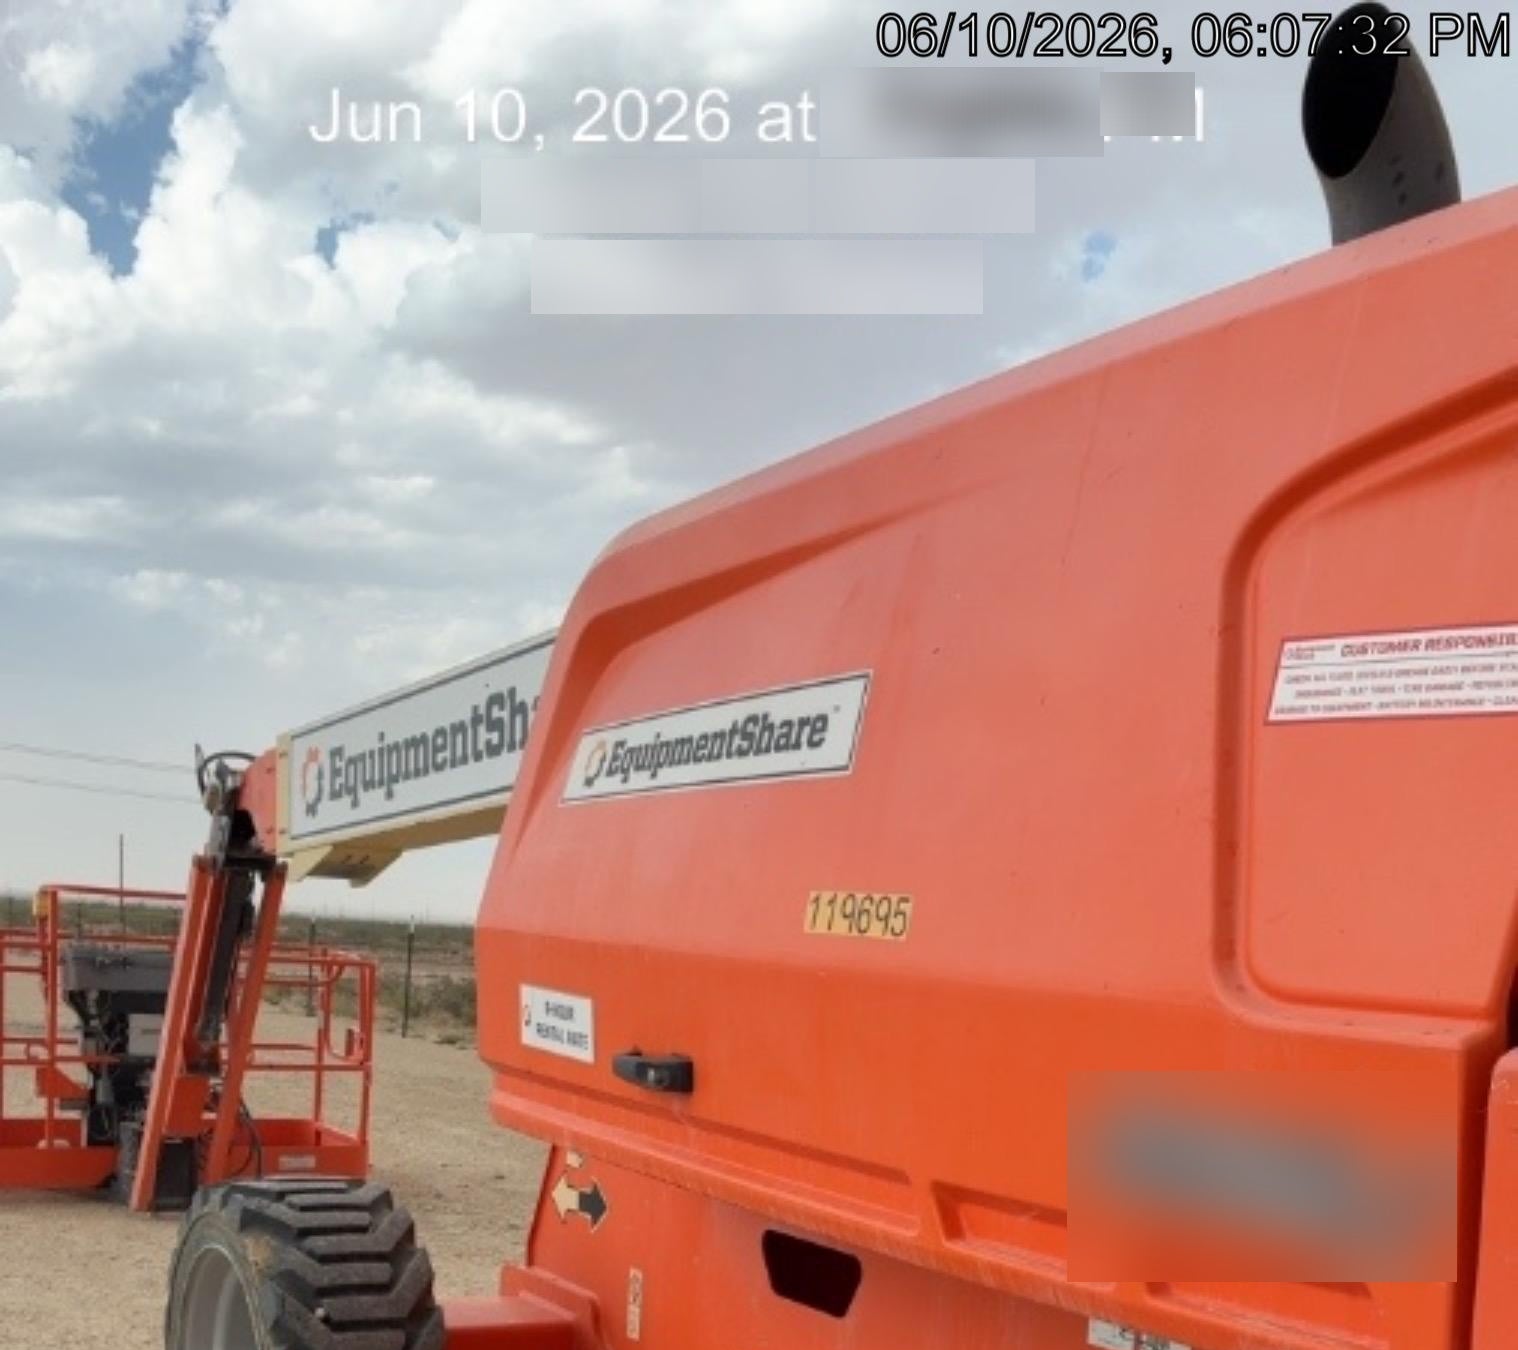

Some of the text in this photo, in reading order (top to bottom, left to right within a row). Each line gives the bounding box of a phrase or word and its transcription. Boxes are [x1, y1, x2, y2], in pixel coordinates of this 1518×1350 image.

[329, 686, 540, 809] EquipmentSh
[605, 712, 829, 784] EquipmentShare
[811, 893, 910, 936] 119695
